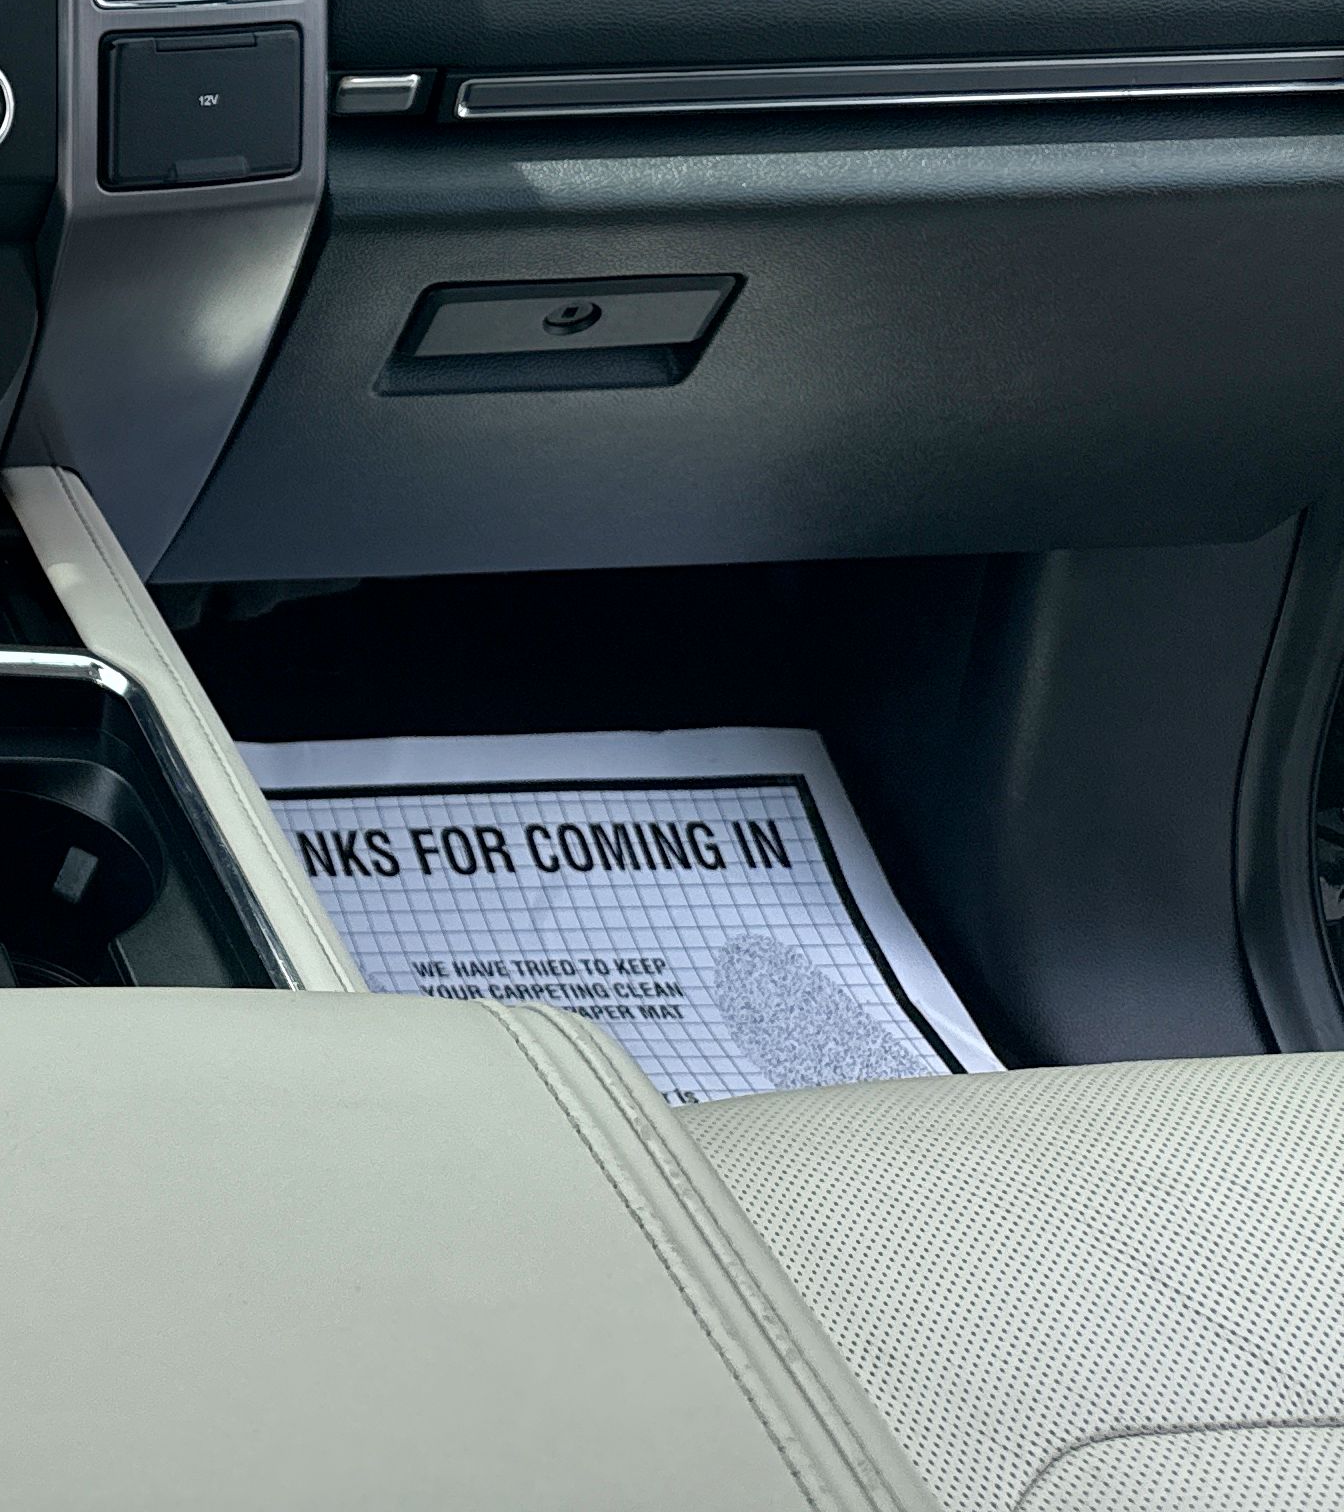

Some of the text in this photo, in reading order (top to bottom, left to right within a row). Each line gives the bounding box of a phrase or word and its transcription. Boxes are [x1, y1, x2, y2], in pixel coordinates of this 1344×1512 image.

[198, 94, 219, 106] 12V
[412, 824, 516, 877] FOR
[525, 820, 727, 875] COMING
[733, 818, 792, 869] IN
[412, 957, 666, 978] WE HAVE TRIED TO KEEP
[419, 981, 684, 1000] YOUR CARPETING CLEAN
[639, 1004, 685, 1020] MAT
